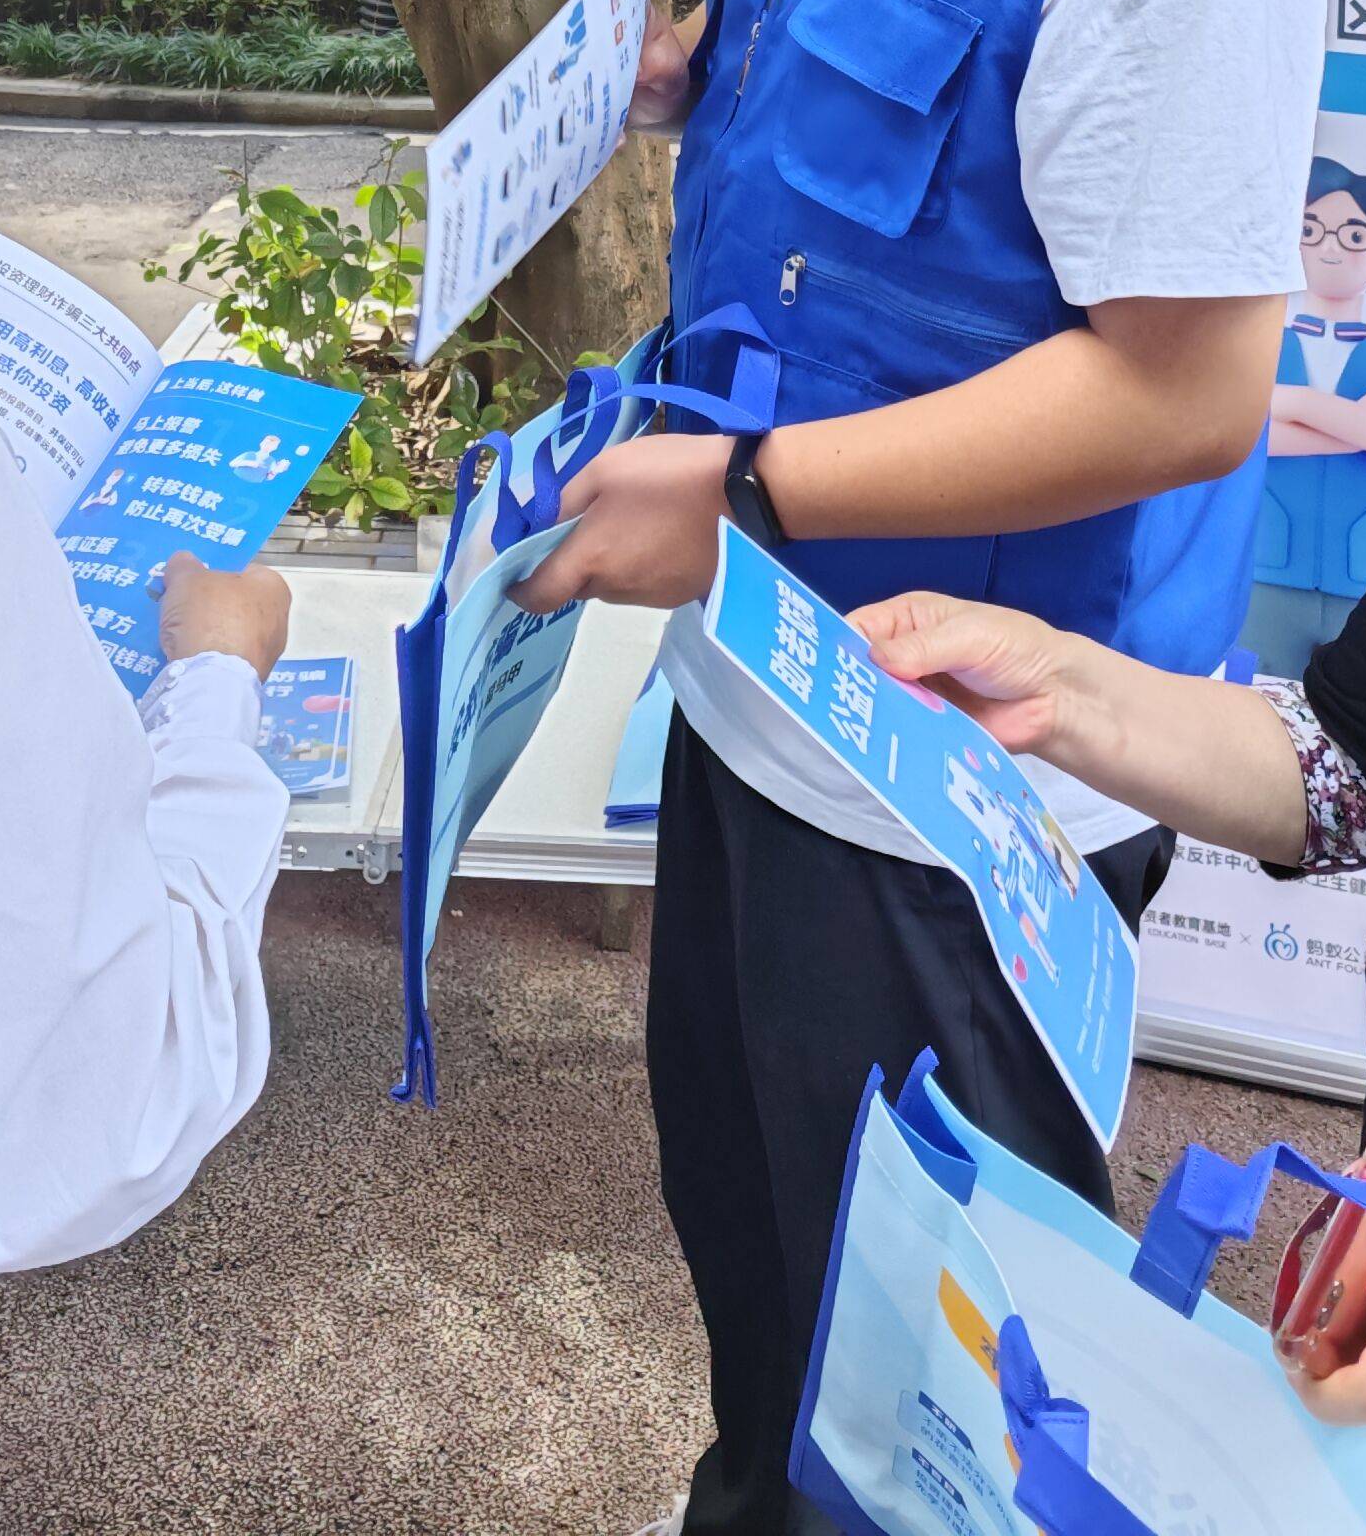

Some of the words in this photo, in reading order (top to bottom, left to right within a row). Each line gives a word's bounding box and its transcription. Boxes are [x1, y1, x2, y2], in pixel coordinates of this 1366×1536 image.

[133, 415, 204, 436] 马上报警
[140, 475, 225, 512] 转移钱款
[1147, 927, 1199, 945] EDUCATION
[1204, 938, 1228, 950] BASE
[1306, 938, 1362, 963] 蚂蚁公
[1305, 957, 1332, 970] ANT
